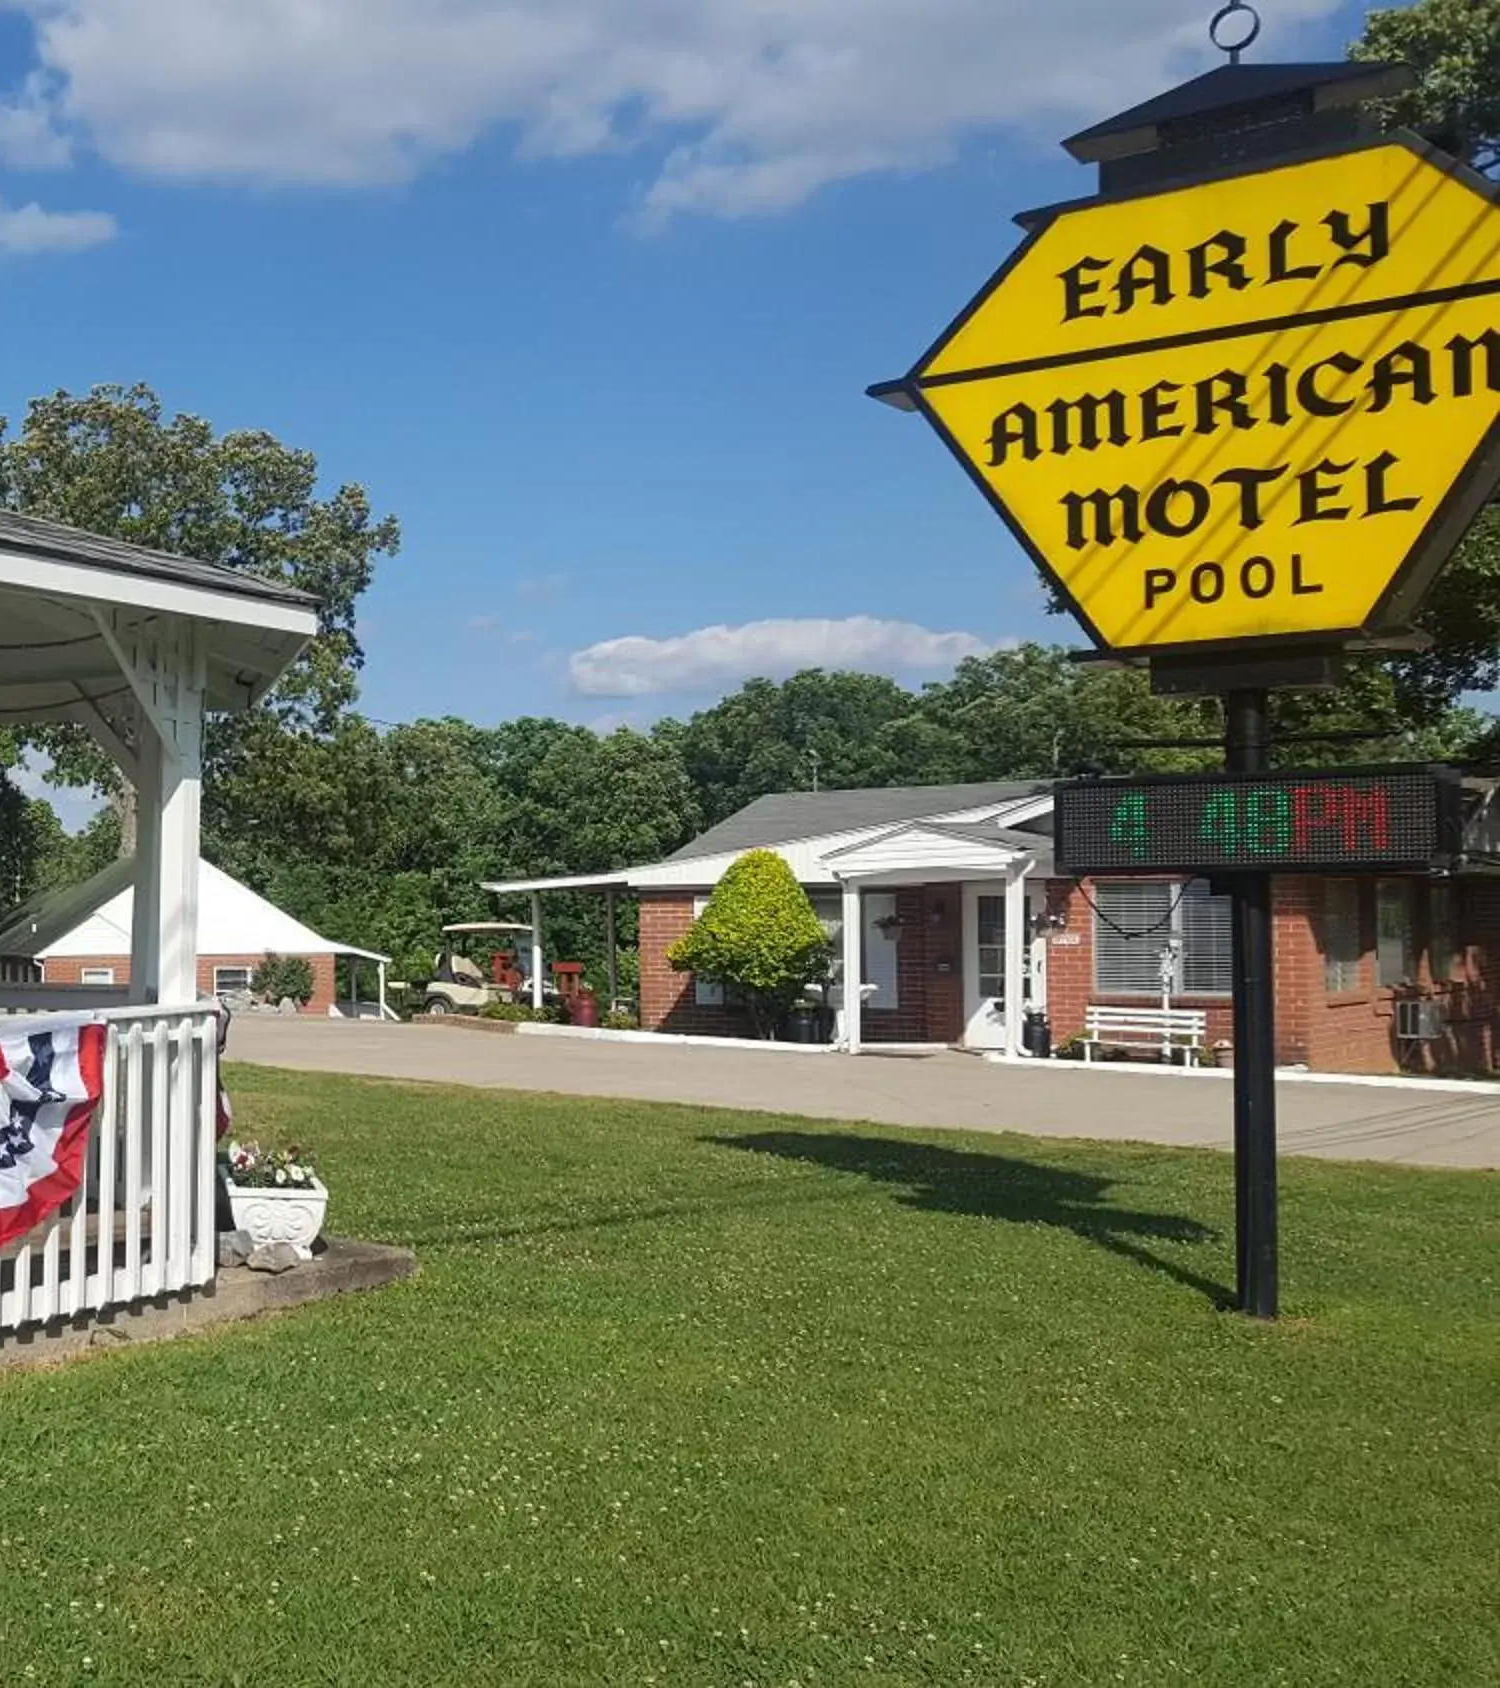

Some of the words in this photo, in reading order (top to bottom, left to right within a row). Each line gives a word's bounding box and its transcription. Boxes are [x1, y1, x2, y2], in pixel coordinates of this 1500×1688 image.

[1058, 201, 1390, 324] EARLY
[985, 326, 1500, 467] AMERICAN
[1060, 450, 1423, 550] MOTEL
[1144, 553, 1323, 609] POOL
